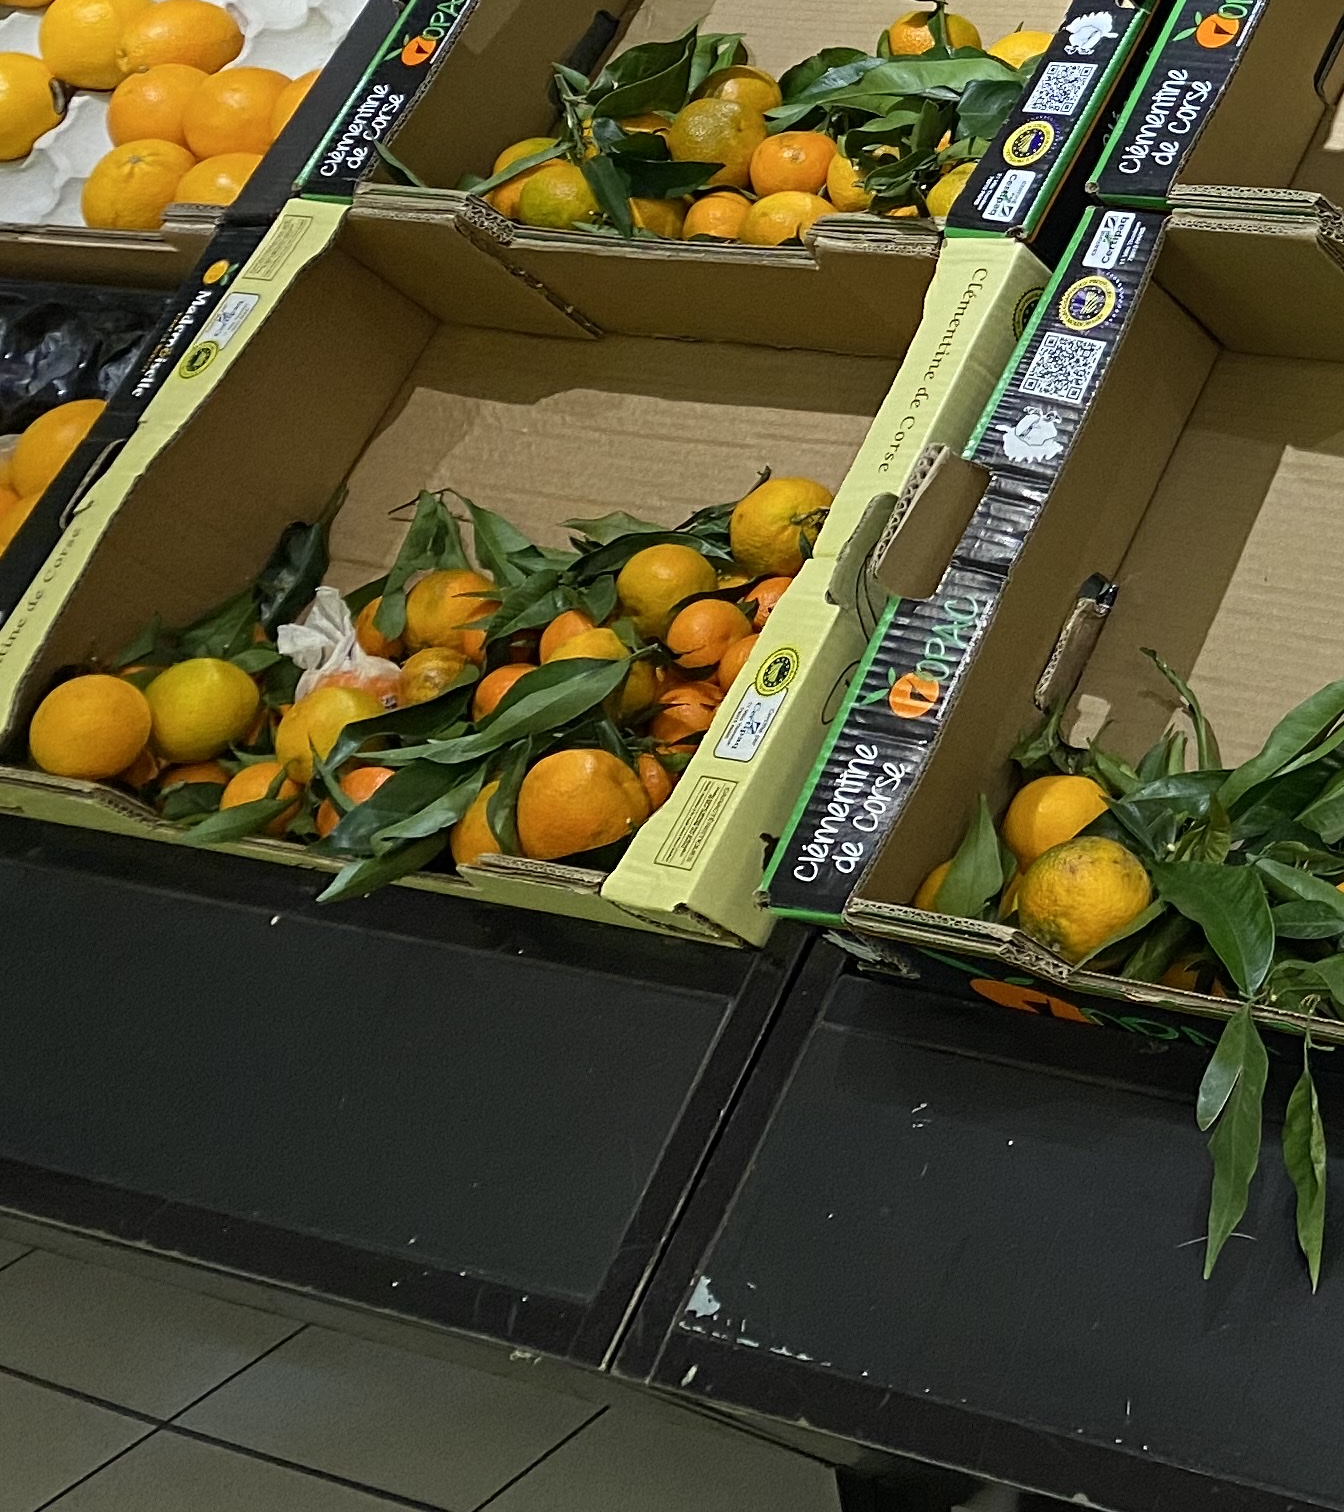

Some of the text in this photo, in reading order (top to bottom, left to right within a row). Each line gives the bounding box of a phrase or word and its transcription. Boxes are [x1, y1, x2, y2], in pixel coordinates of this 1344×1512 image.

[319, 83, 389, 178] Clémentine
[345, 144, 367, 170] de
[1118, 68, 1188, 174] Clémentine
[1155, 137, 1182, 166] de
[1101, 216, 1130, 263] Certipaq
[132, 290, 212, 398] Mademoiselle
[878, 265, 988, 474] Clémentine de Corse
[27, 524, 83, 613] de Corse
[921, 593, 981, 684] OPAC
[793, 742, 879, 884] Clémentine
[835, 832, 865, 875] de
